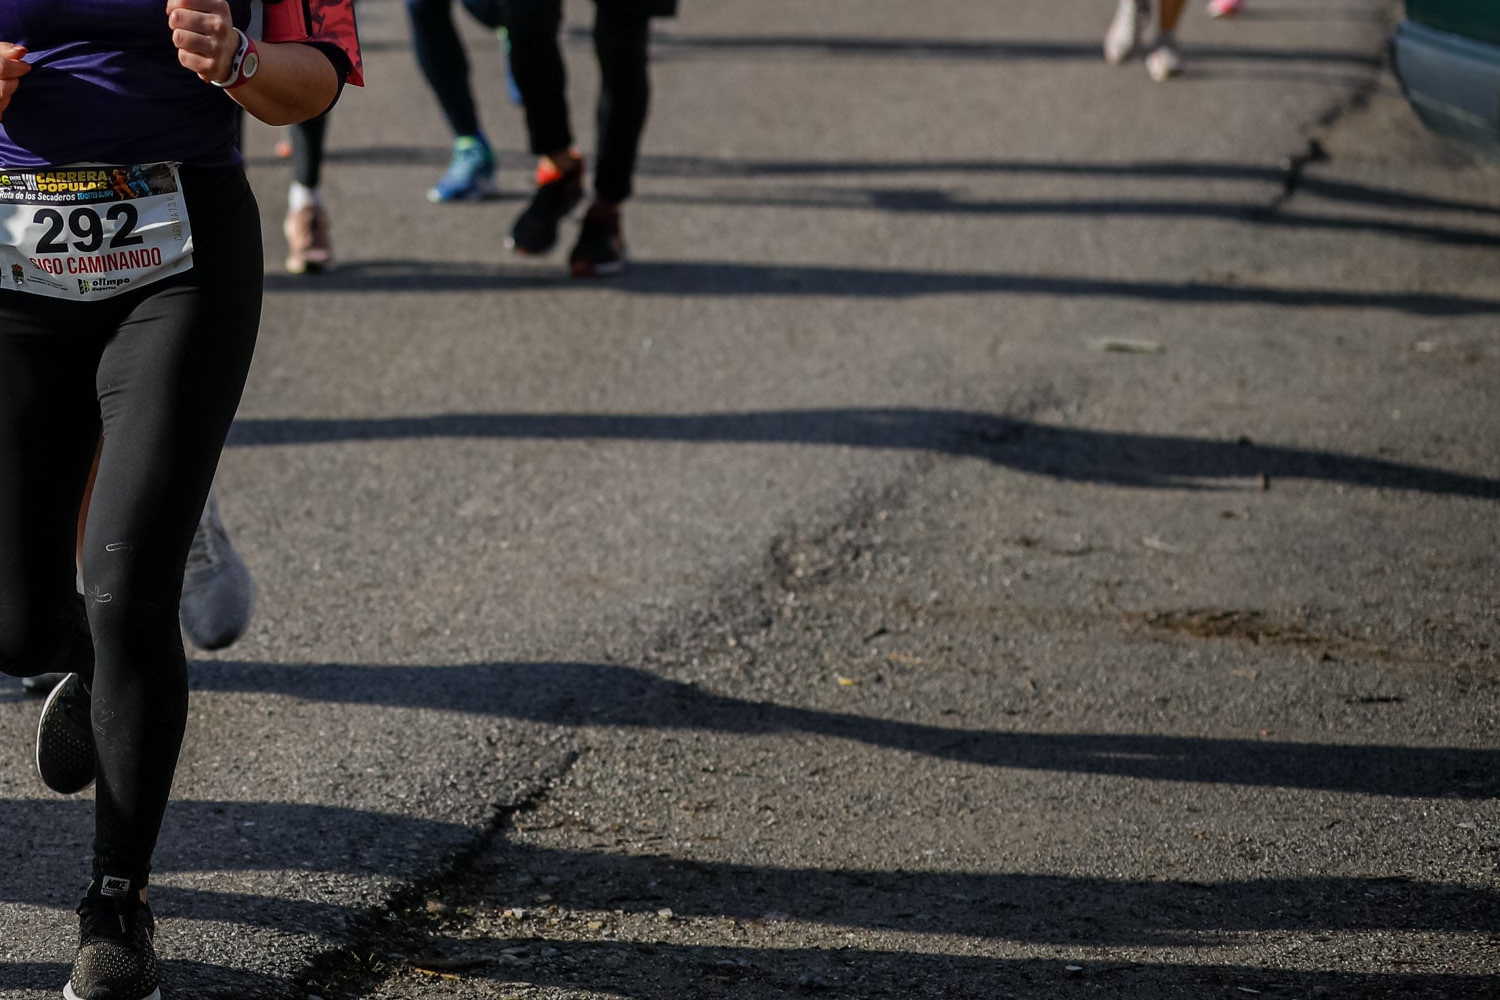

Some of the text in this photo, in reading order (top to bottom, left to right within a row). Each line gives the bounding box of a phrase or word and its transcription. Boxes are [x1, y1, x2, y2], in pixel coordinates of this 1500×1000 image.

[36, 171, 108, 183] CARRERA
[38, 181, 107, 192] POPULAR
[0, 191, 14, 200] Ruta
[15, 192, 24, 200] de
[25, 191, 35, 200] los
[37, 192, 76, 201] Secaderos
[33, 203, 144, 254] 292
[67, 247, 162, 274] CAMINANDO
[105, 879, 128, 890] NIKE
